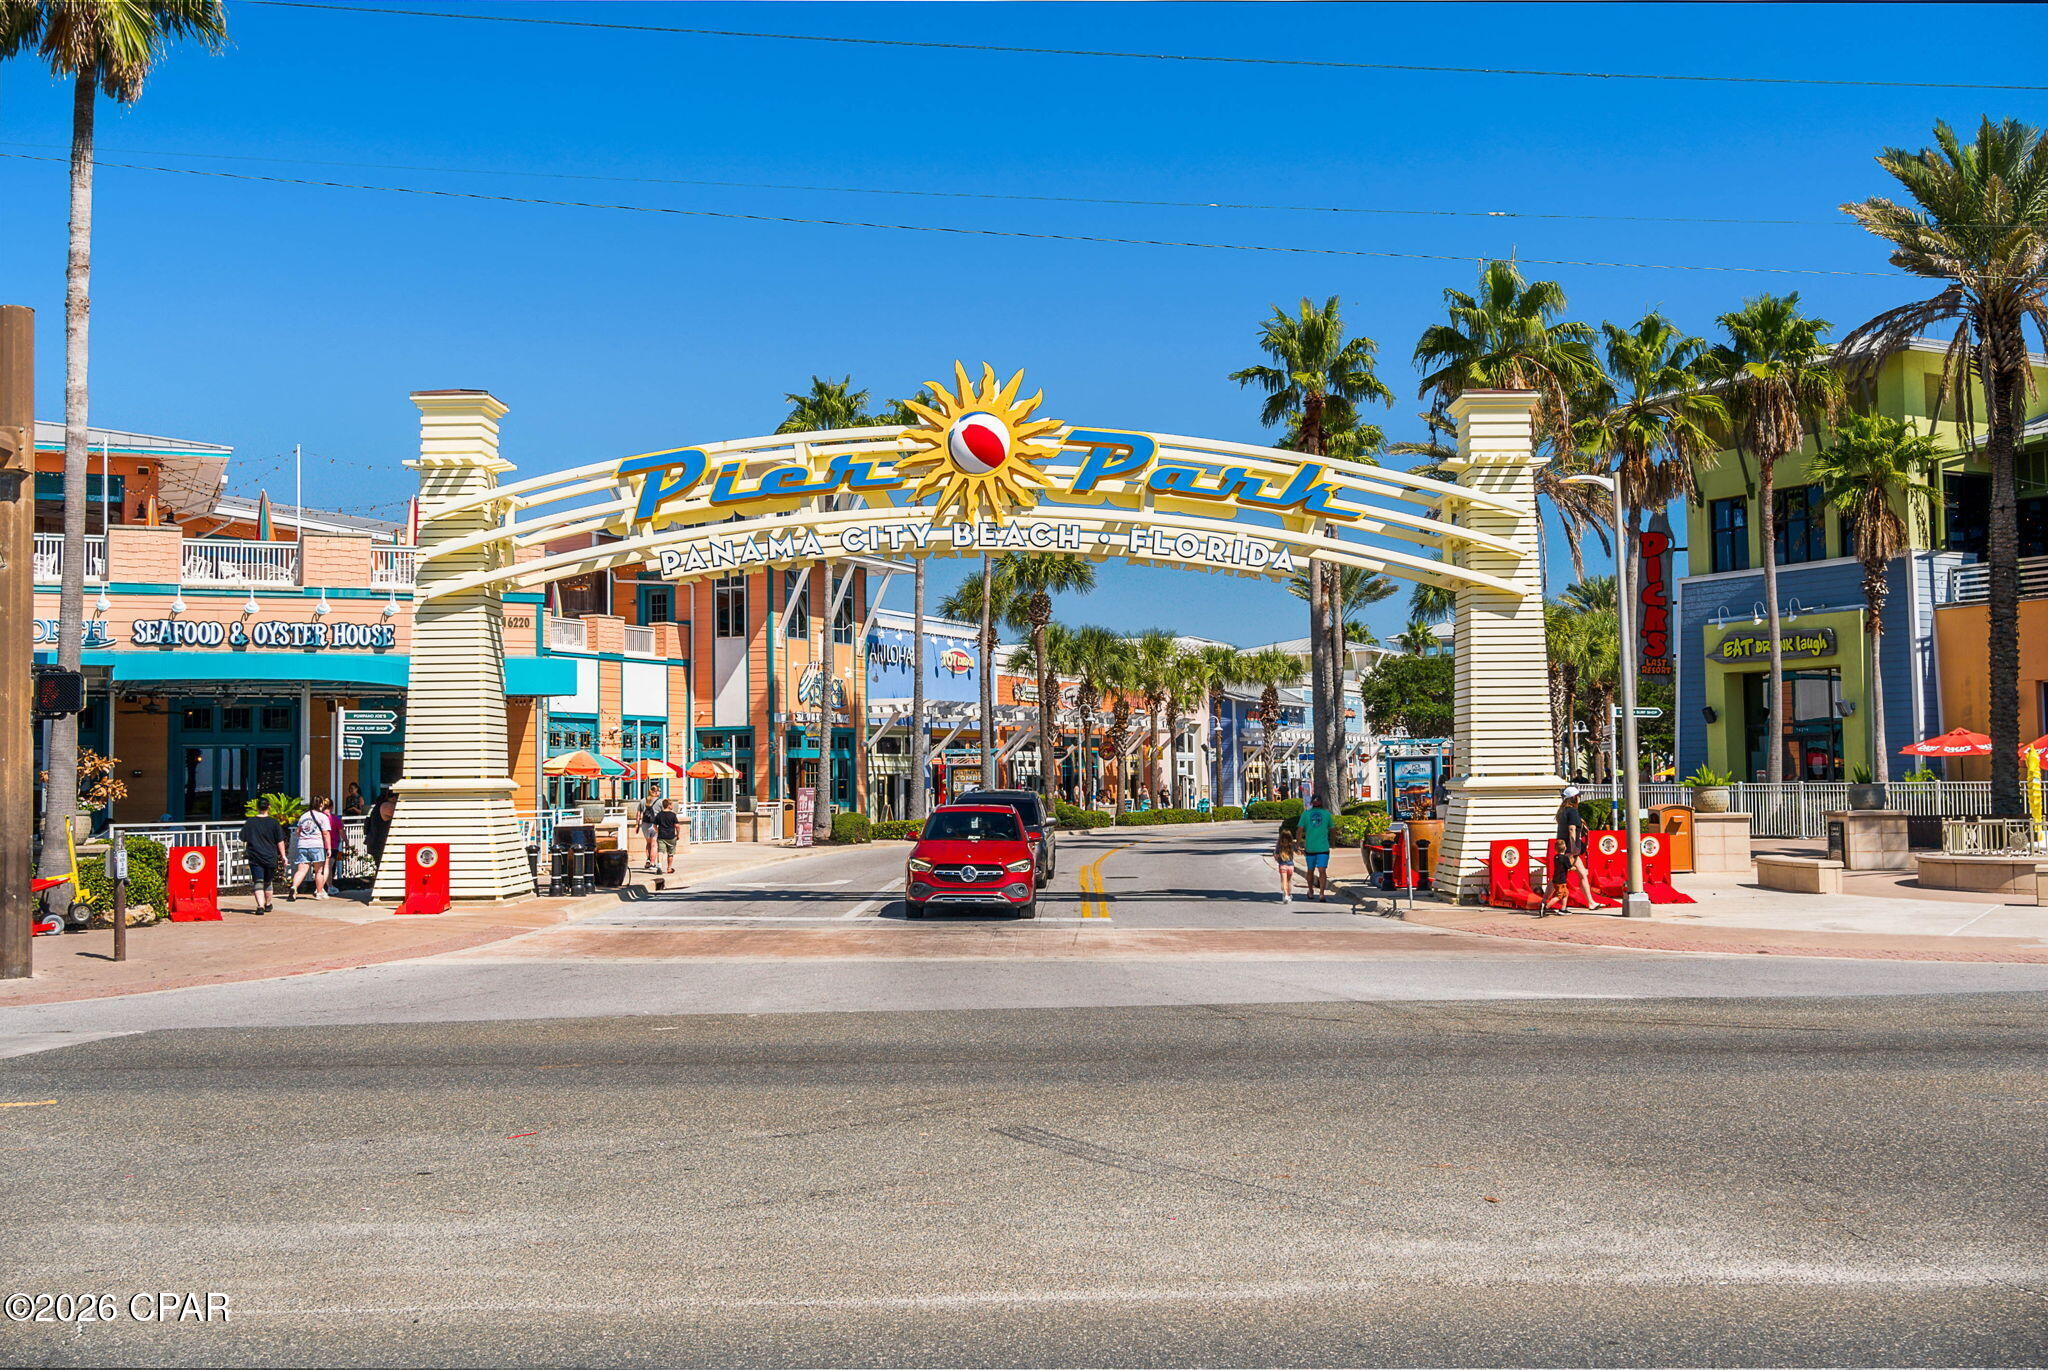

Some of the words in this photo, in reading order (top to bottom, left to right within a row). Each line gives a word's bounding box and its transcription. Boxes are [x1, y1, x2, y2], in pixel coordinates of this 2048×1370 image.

[612, 447, 907, 524] Pier
[1059, 427, 1367, 521] Park
[660, 530, 824, 576] PANAMA
[841, 523, 934, 552] CITY
[952, 522, 1080, 548] BEACH
[1129, 530, 1295, 573] FLORIDA
[1639, 531, 1670, 658] DICK'S
[131, 619, 225, 647] SEAFOOD
[229, 620, 250, 647] &
[252, 620, 328, 648] OYSTER
[330, 621, 396, 649] HOUSE
[1723, 637, 1755, 658] EAT
[1755, 637, 1795, 653] DRNK
[1794, 632, 1828, 656] laugh
[1641, 665, 1673, 674] RESORT
[1645, 658, 1668, 667] LAST
